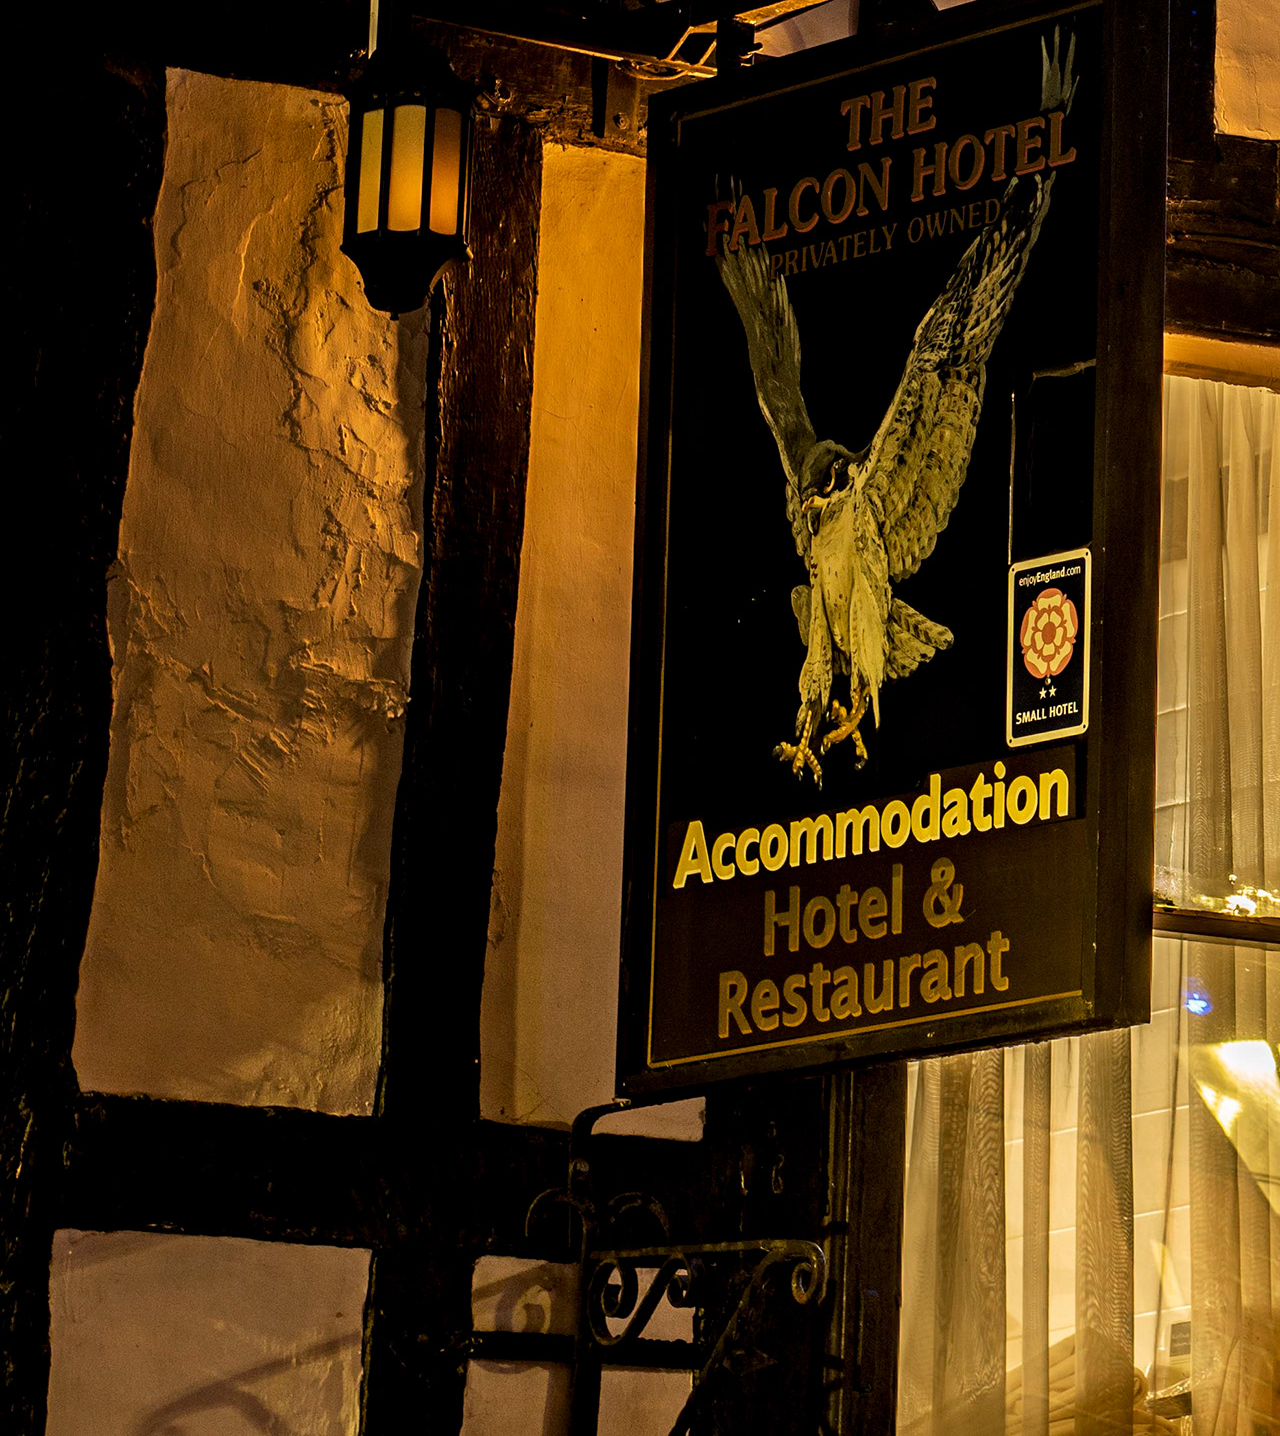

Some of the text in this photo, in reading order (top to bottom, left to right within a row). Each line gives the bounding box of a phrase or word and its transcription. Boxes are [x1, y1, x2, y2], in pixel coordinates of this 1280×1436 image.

[840, 77, 937, 151] THE
[705, 111, 1077, 256] FALCON HOTEL
[769, 198, 1001, 280] PRIVATELY OWNED
[1019, 565, 1081, 587] enjoyEngland.com
[1015, 701, 1079, 725] SMALL HOTEL
[673, 761, 1069, 889] Accommodation
[764, 857, 964, 956] Hotel &
[718, 931, 1010, 1038] Restaurant
